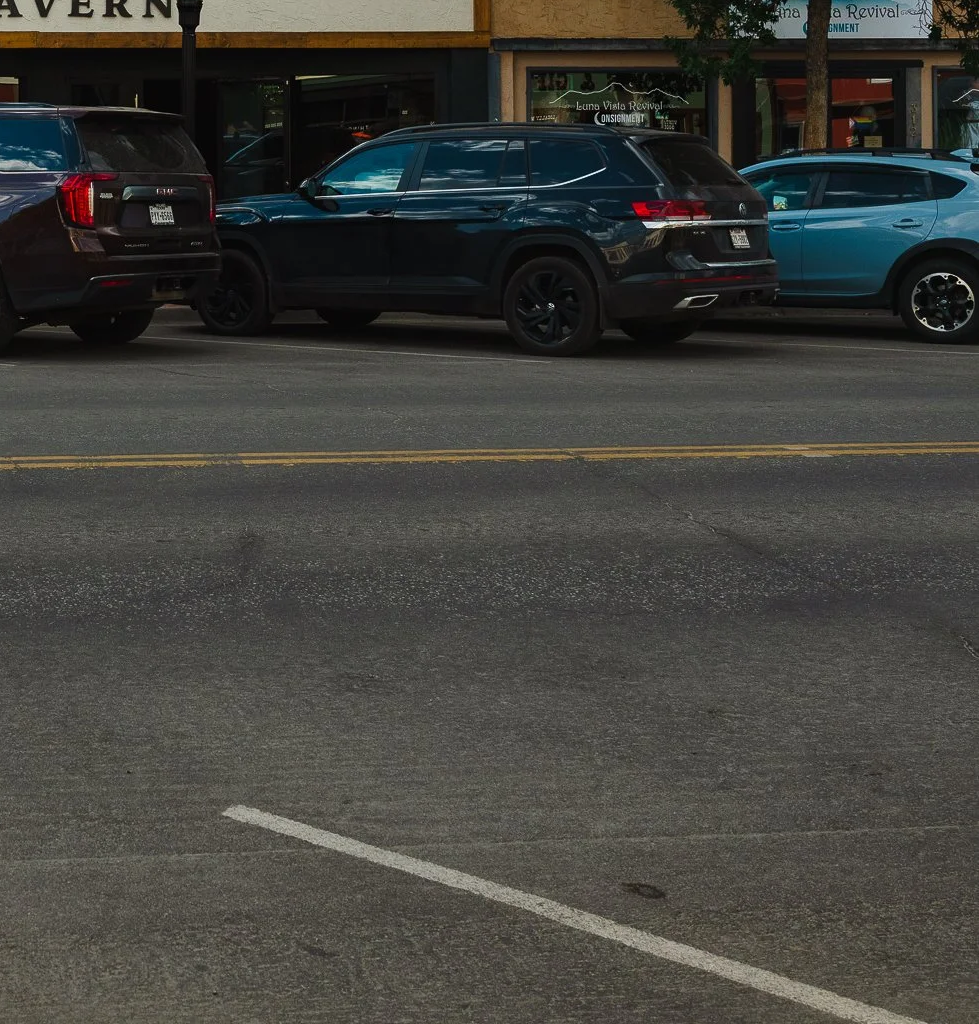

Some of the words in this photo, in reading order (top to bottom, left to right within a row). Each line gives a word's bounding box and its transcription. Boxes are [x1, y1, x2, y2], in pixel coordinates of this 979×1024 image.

[845, 3, 899, 20] Revival
[575, 101, 600, 111] Luna
[602, 100, 626, 110] Vista
[629, 100, 663, 112] Revival
